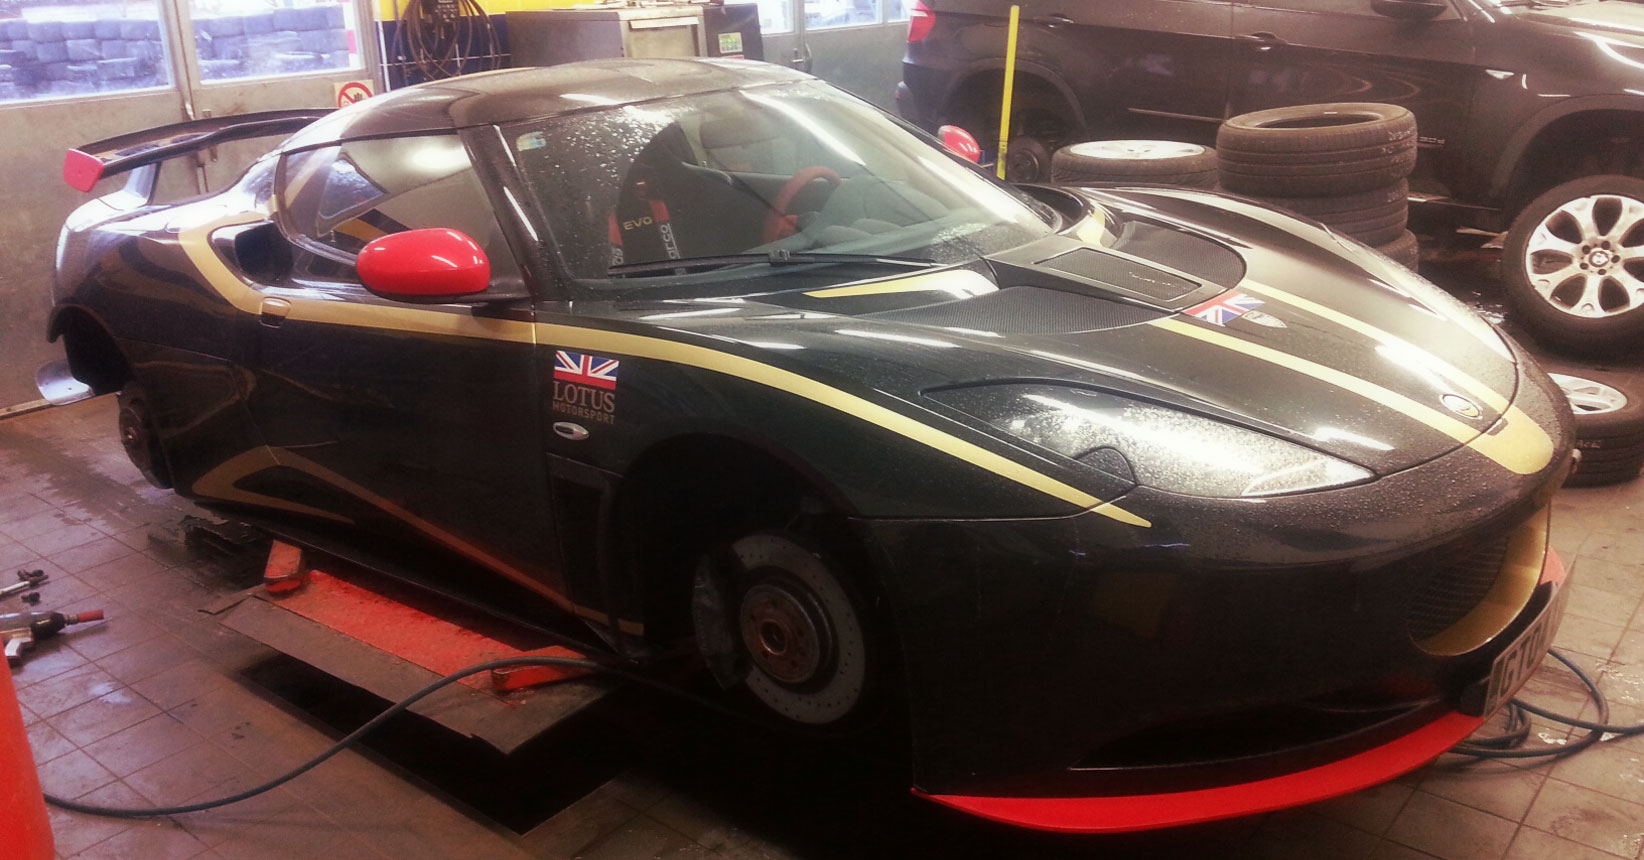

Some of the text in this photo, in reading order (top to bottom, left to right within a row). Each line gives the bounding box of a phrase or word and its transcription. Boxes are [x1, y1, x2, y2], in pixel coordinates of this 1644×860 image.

[623, 216, 653, 230] EVO
[660, 222, 680, 260] arco
[552, 381, 615, 413] LOTUS
[552, 401, 615, 424] MOTORSPORT
